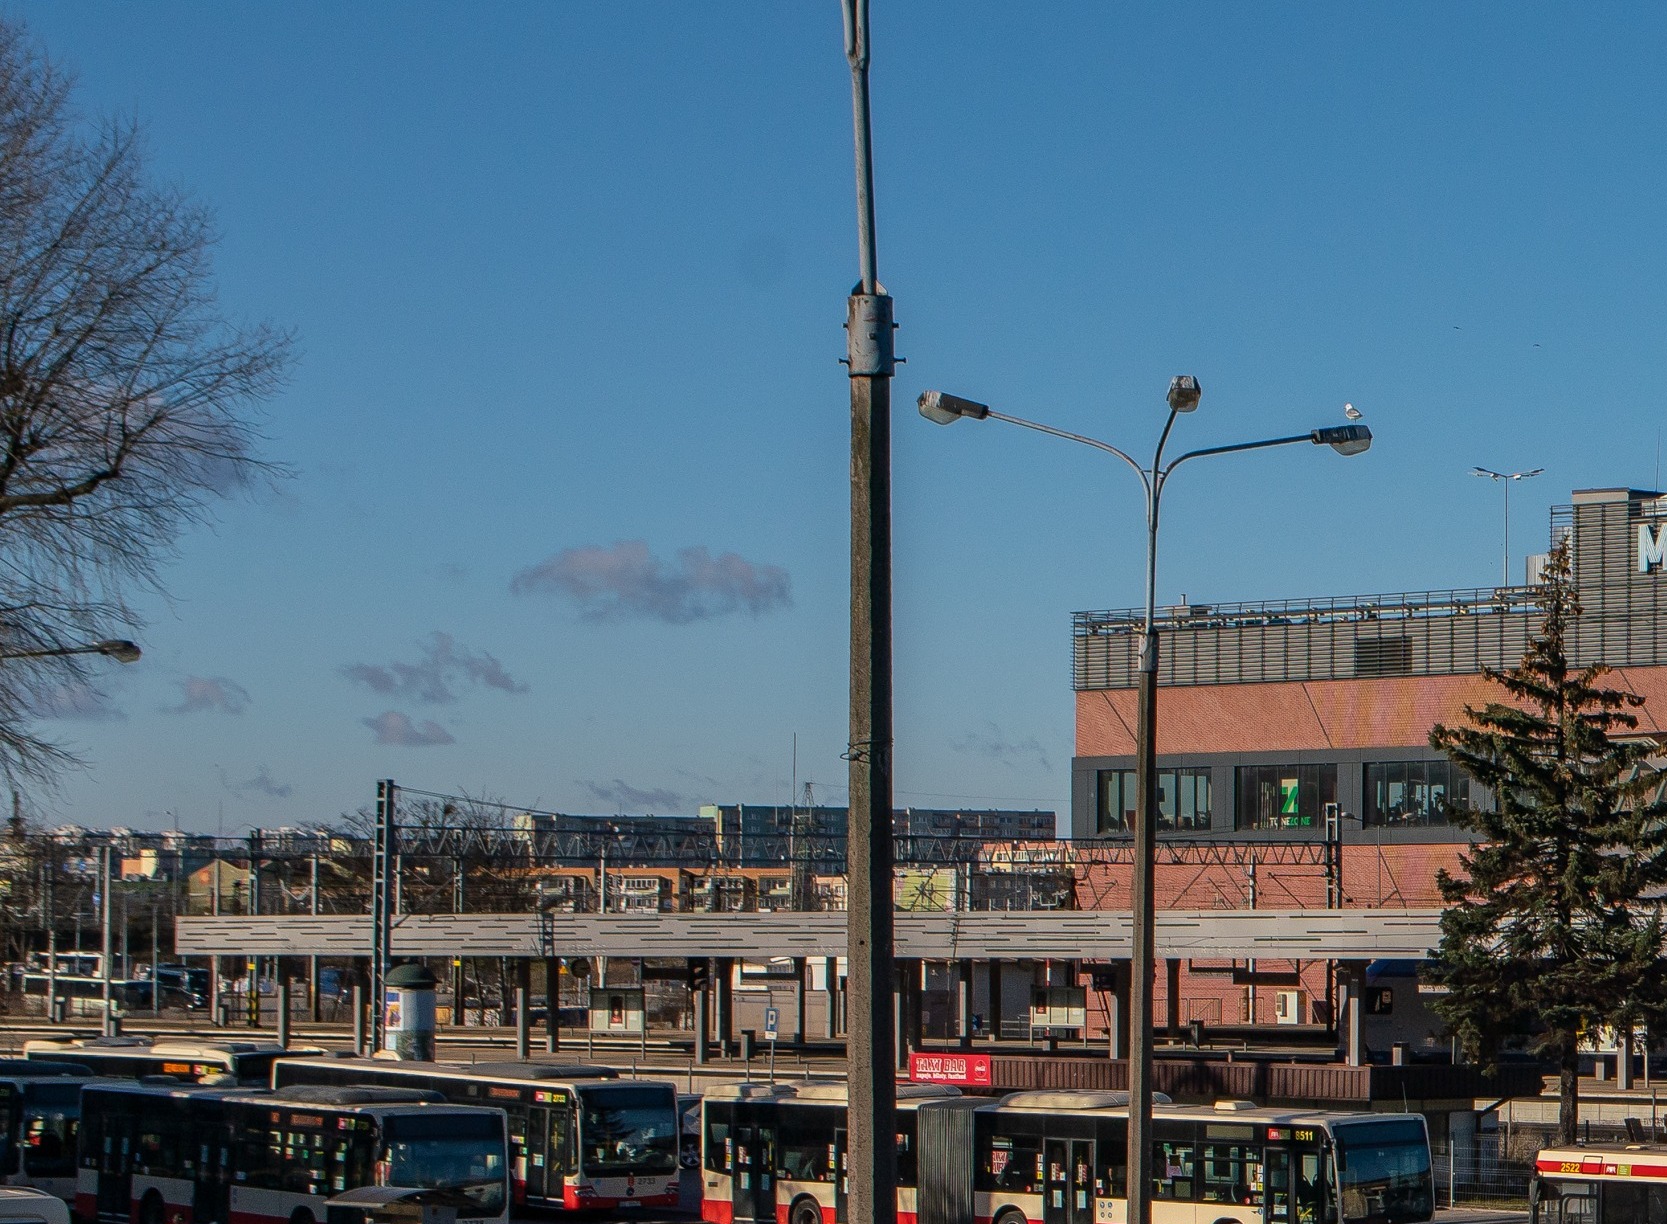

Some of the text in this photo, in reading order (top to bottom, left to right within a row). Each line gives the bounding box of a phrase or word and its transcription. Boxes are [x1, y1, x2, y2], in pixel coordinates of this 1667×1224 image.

[916, 1057, 967, 1073] TAXI BAR
[1295, 1130, 1313, 1141] 8511
[1560, 1162, 1580, 1173] 2522
